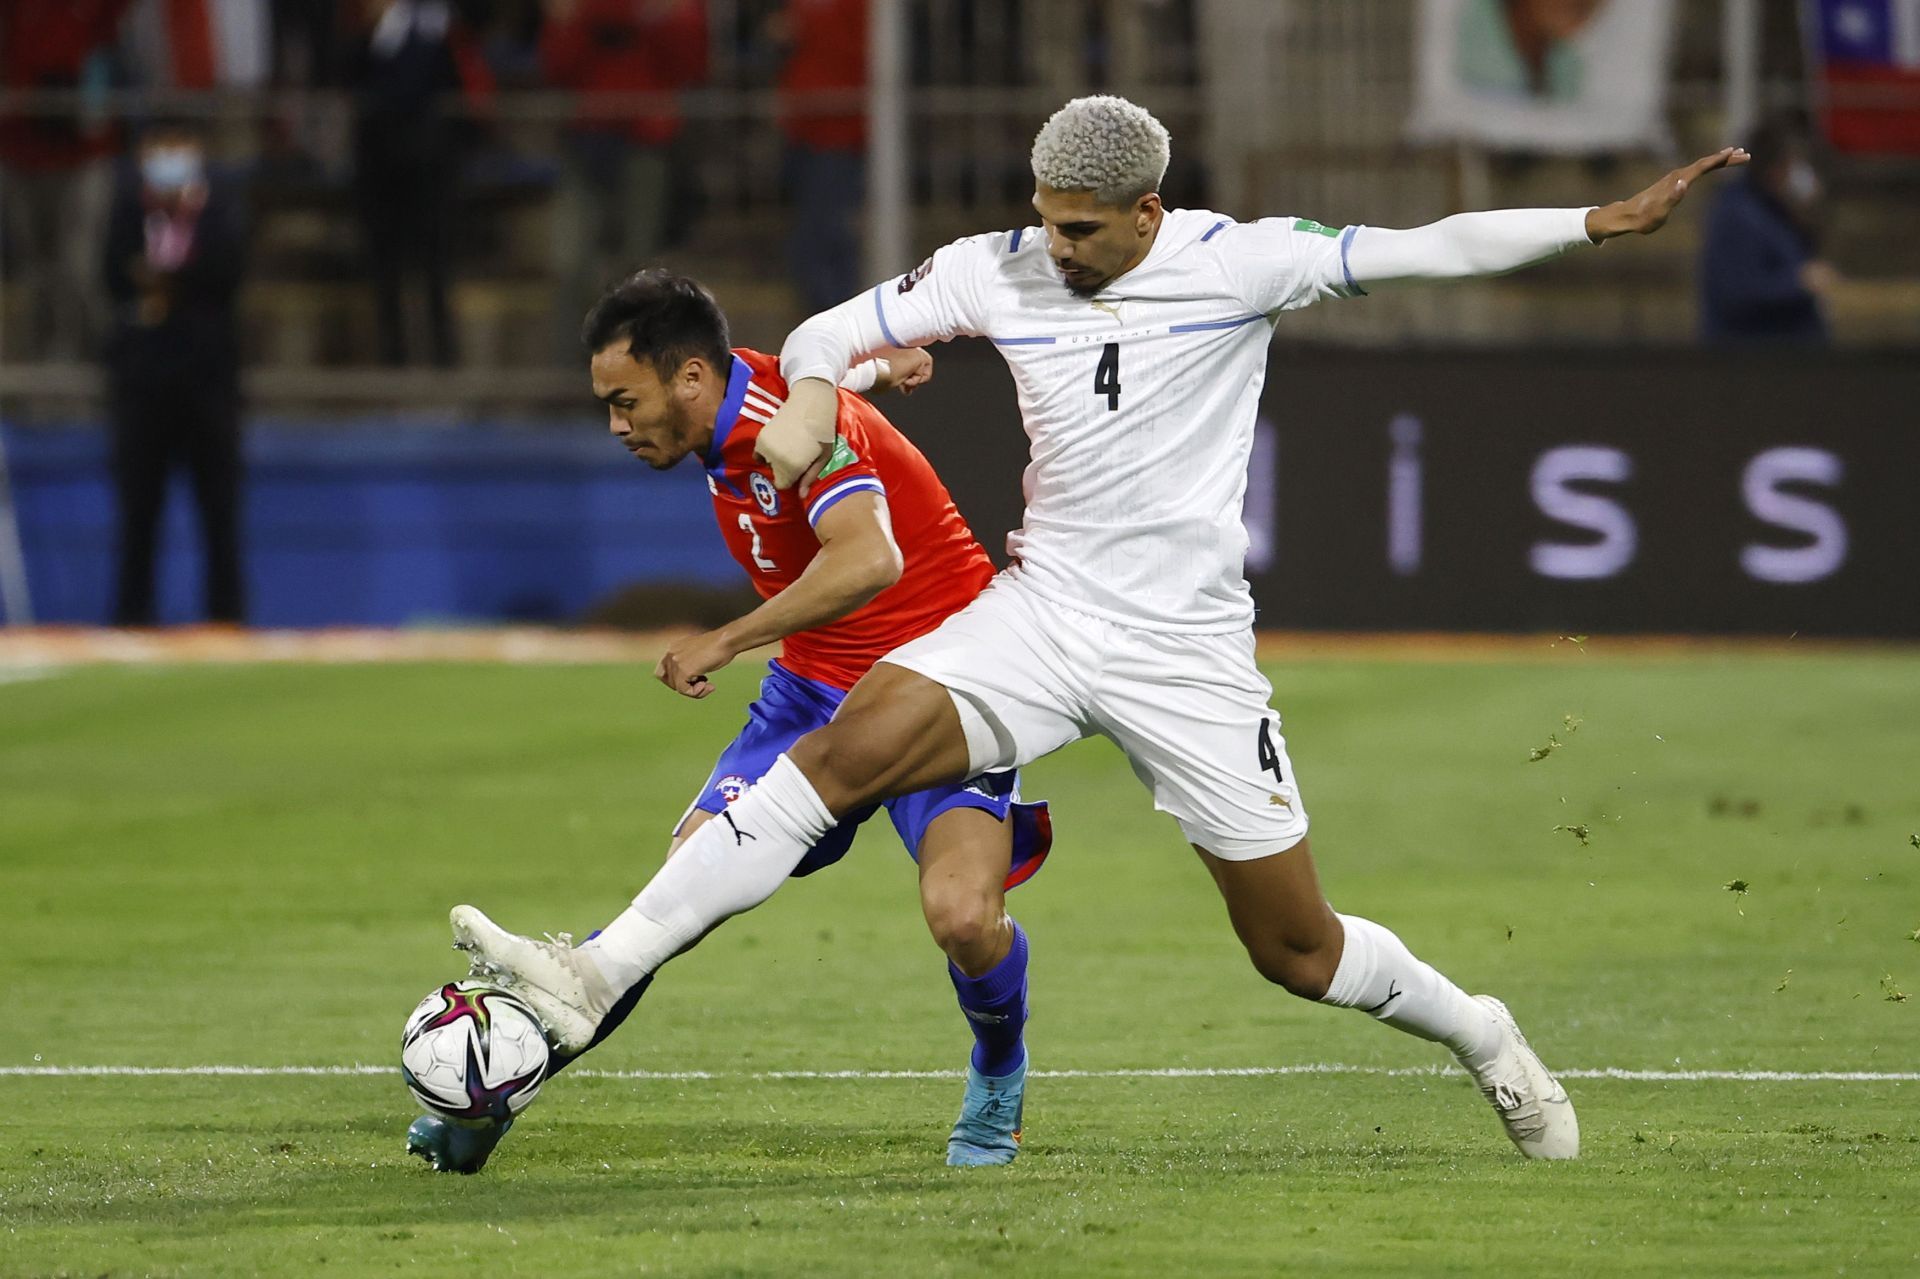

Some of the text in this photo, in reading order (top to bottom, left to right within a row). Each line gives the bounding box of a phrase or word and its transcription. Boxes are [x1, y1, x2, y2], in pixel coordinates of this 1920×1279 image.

[1094, 342, 1121, 411] 4
[738, 512, 780, 572] 2
[1258, 717, 1283, 783] 4
